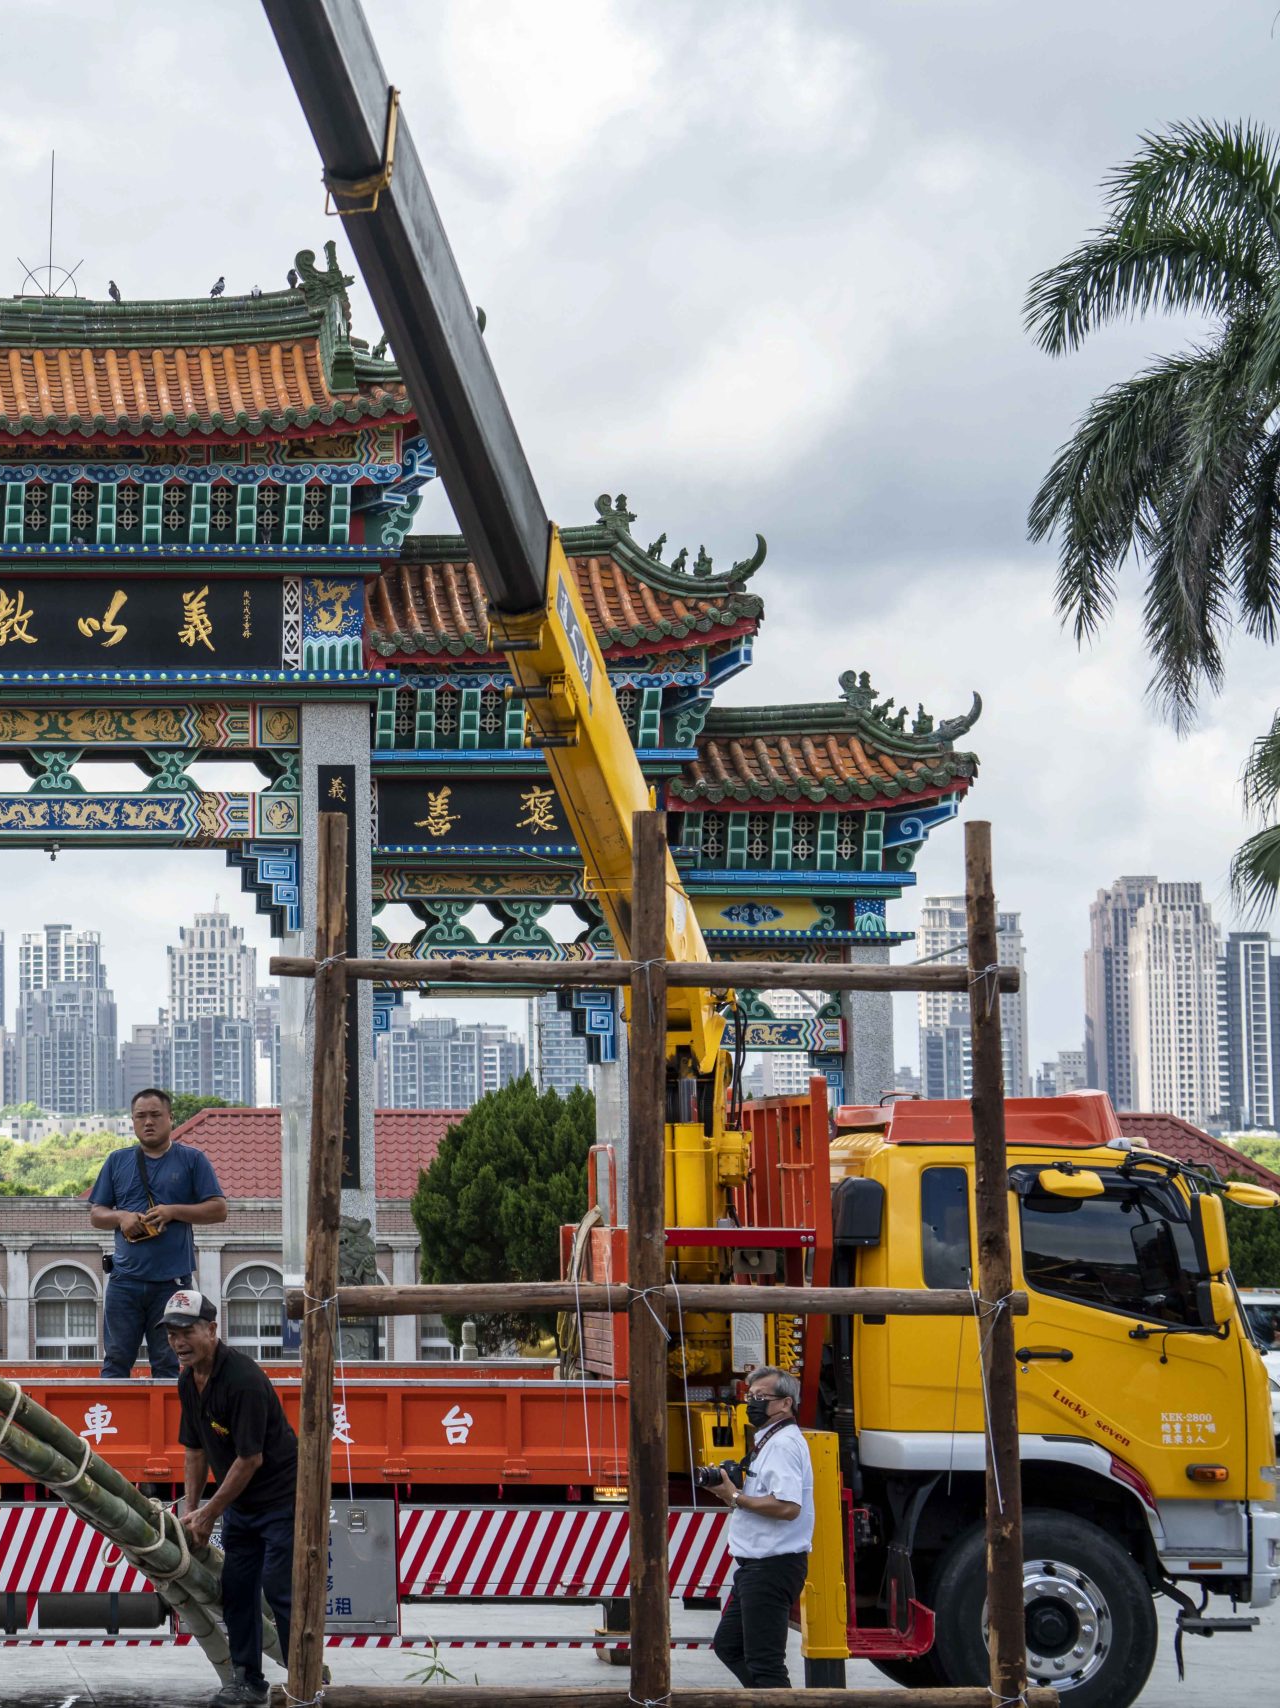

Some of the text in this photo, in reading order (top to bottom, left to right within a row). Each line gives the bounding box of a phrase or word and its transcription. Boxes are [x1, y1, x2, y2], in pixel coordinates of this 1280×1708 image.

[1052, 1389, 1131, 1447] Lucky seven
[1161, 1412, 1213, 1422] KEK-2800
